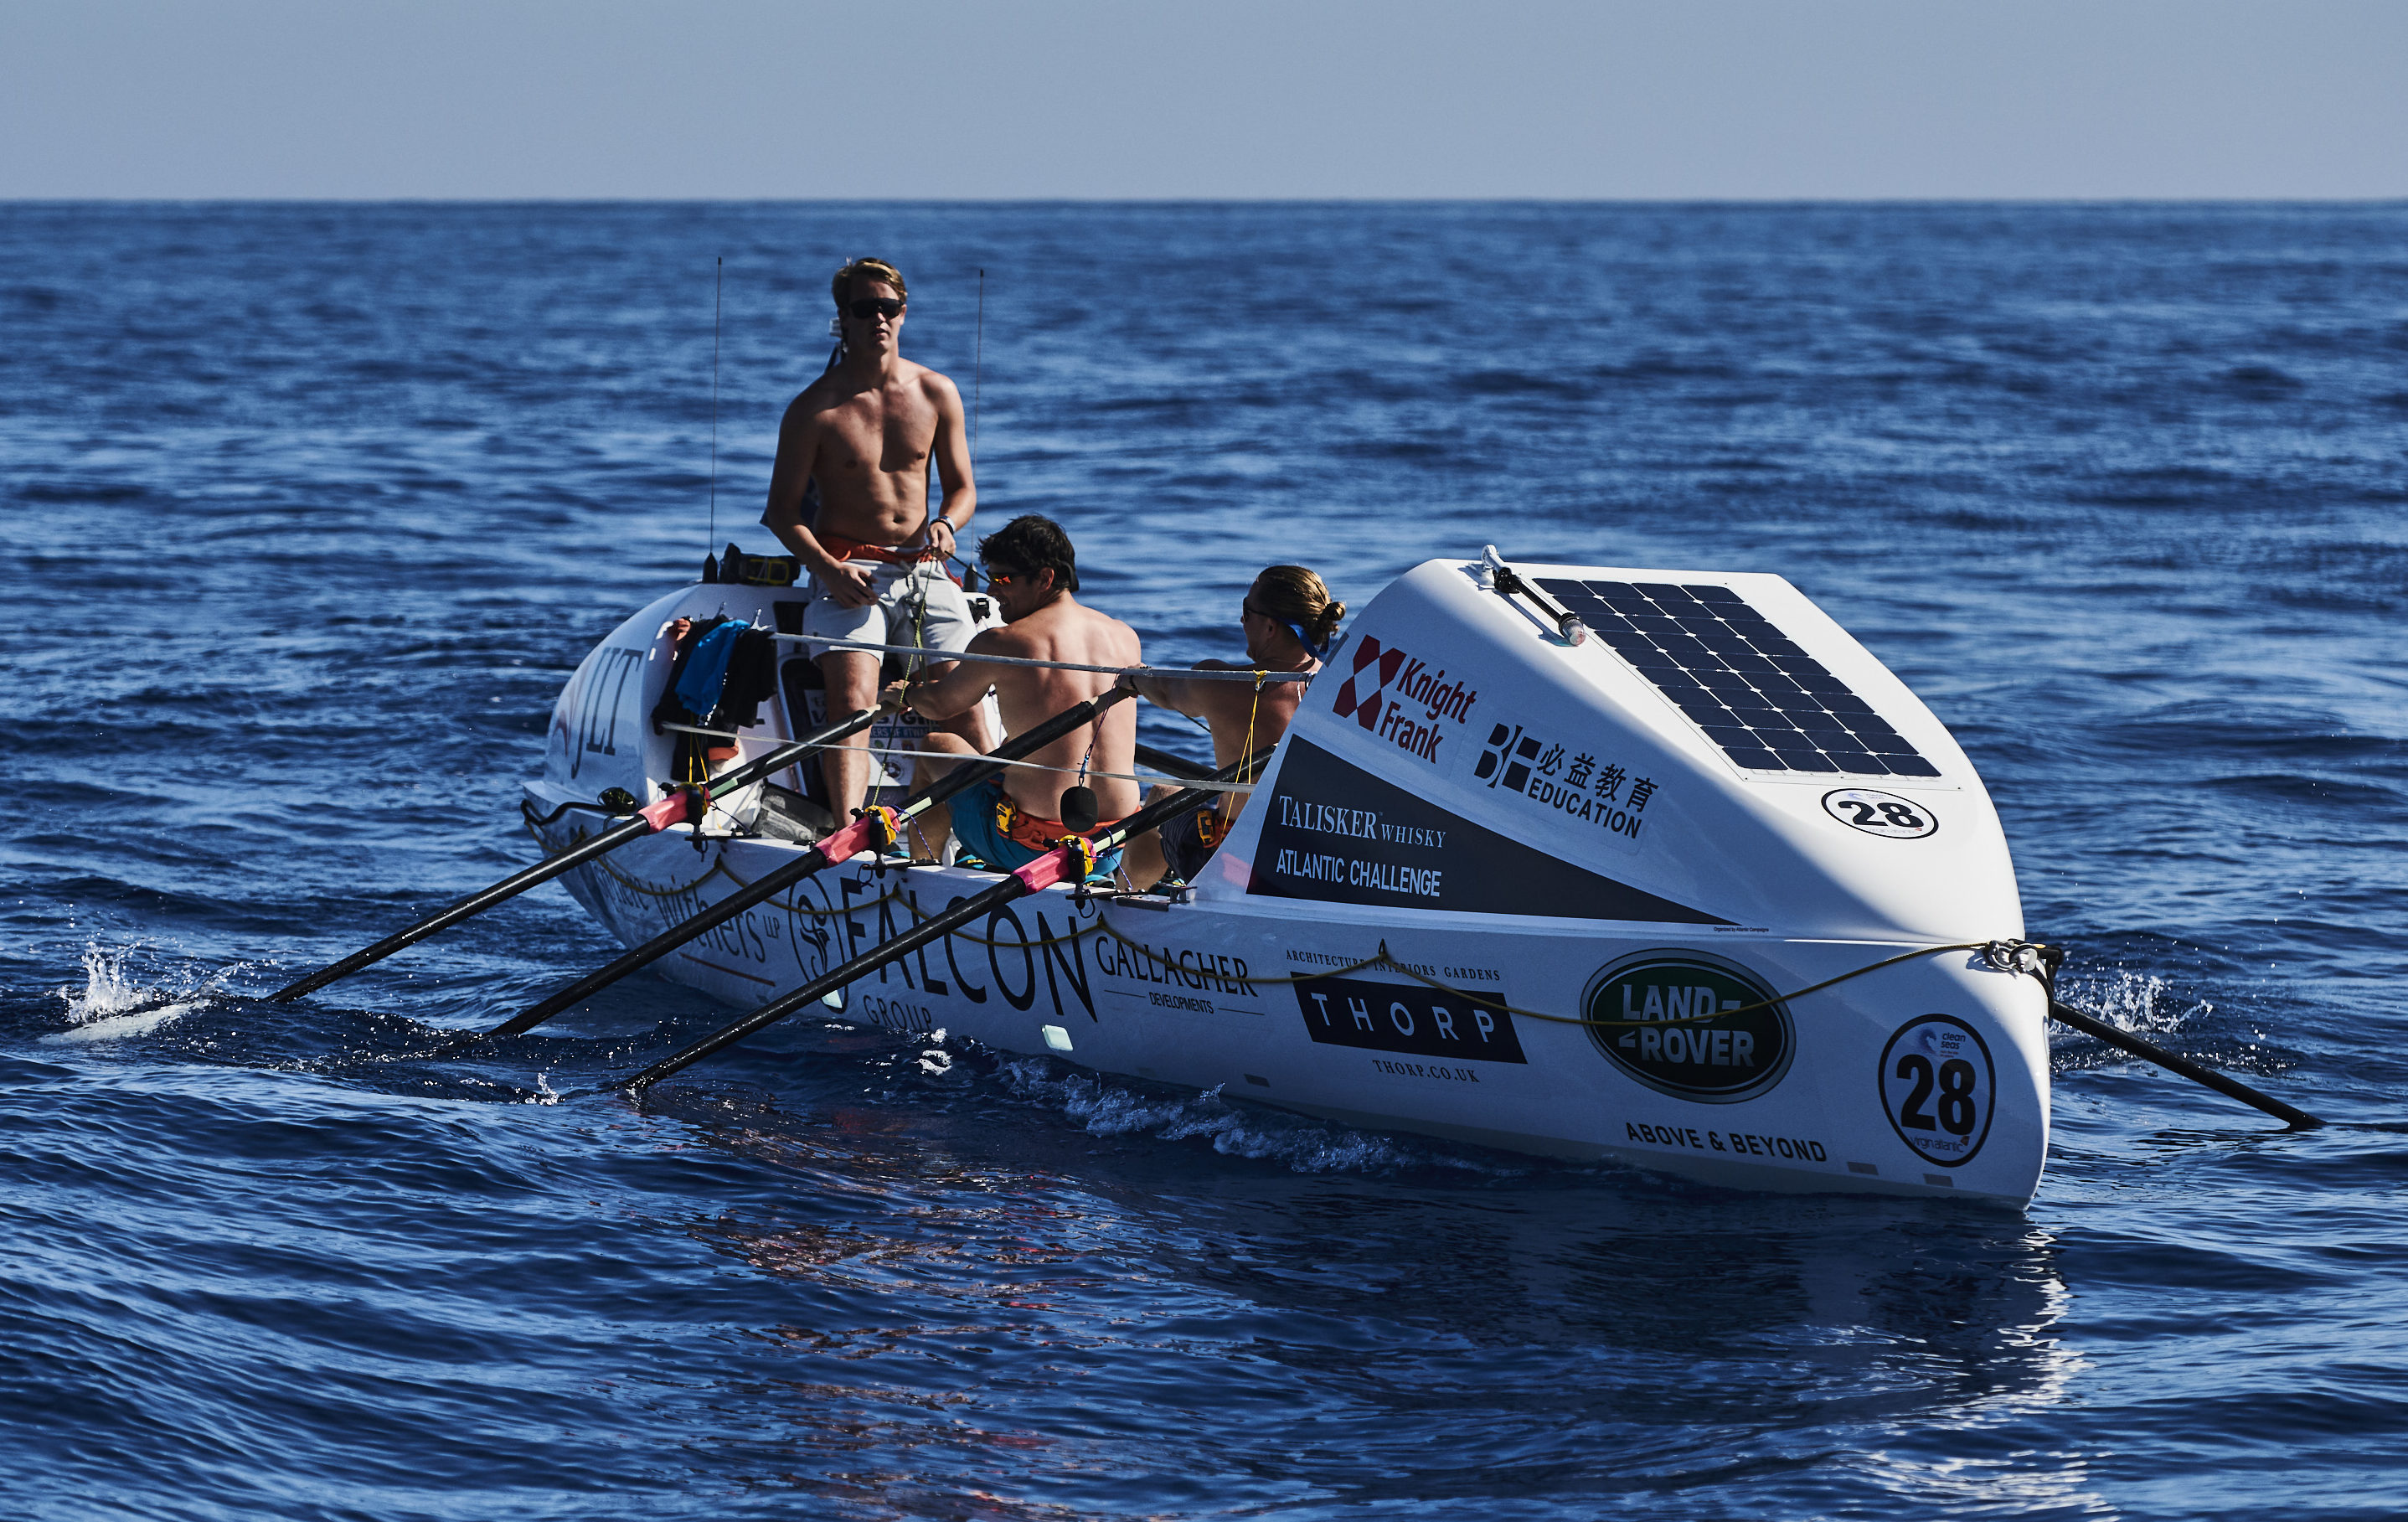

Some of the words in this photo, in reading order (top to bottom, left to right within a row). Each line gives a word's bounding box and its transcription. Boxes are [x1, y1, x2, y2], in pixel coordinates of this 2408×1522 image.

[571, 647, 644, 779] JLT
[1396, 657, 1477, 725] Knight
[1379, 701, 1443, 764] Frank
[1537, 743, 1659, 813] 必益教育
[1279, 795, 1377, 839] TALISKER
[1381, 823, 1446, 848] WHISKY
[1528, 777, 1642, 838] EDUCATION
[1838, 800, 1924, 828] 28
[1276, 849, 1344, 883] ATLANTIC
[1350, 859, 1441, 897] CHALLENGE
[763, 915, 781, 939] LLP
[841, 877, 1097, 1022] FALCON
[1096, 936, 1258, 997] GALLAGHER
[1287, 950, 1366, 970] ARCHITECTURE
[1374, 957, 1436, 977] INTERIORS
[1444, 967, 1500, 981] GARDENS
[864, 995, 932, 1031] GROUP
[1149, 992, 1214, 1014] DEVELOPMENTS
[1311, 993, 1494, 1043] THORP
[1641, 1029, 1754, 1068] ROVER
[1941, 1032, 1966, 1042] clean
[1941, 1041, 1960, 1050] seas
[1373, 1060, 1480, 1083] THORP.CO.UK
[1896, 1054, 1976, 1135] 28
[1627, 1122, 1704, 1150] ABOVE
[1710, 1131, 1726, 1153] &
[1730, 1133, 1827, 1162] BEYOND
